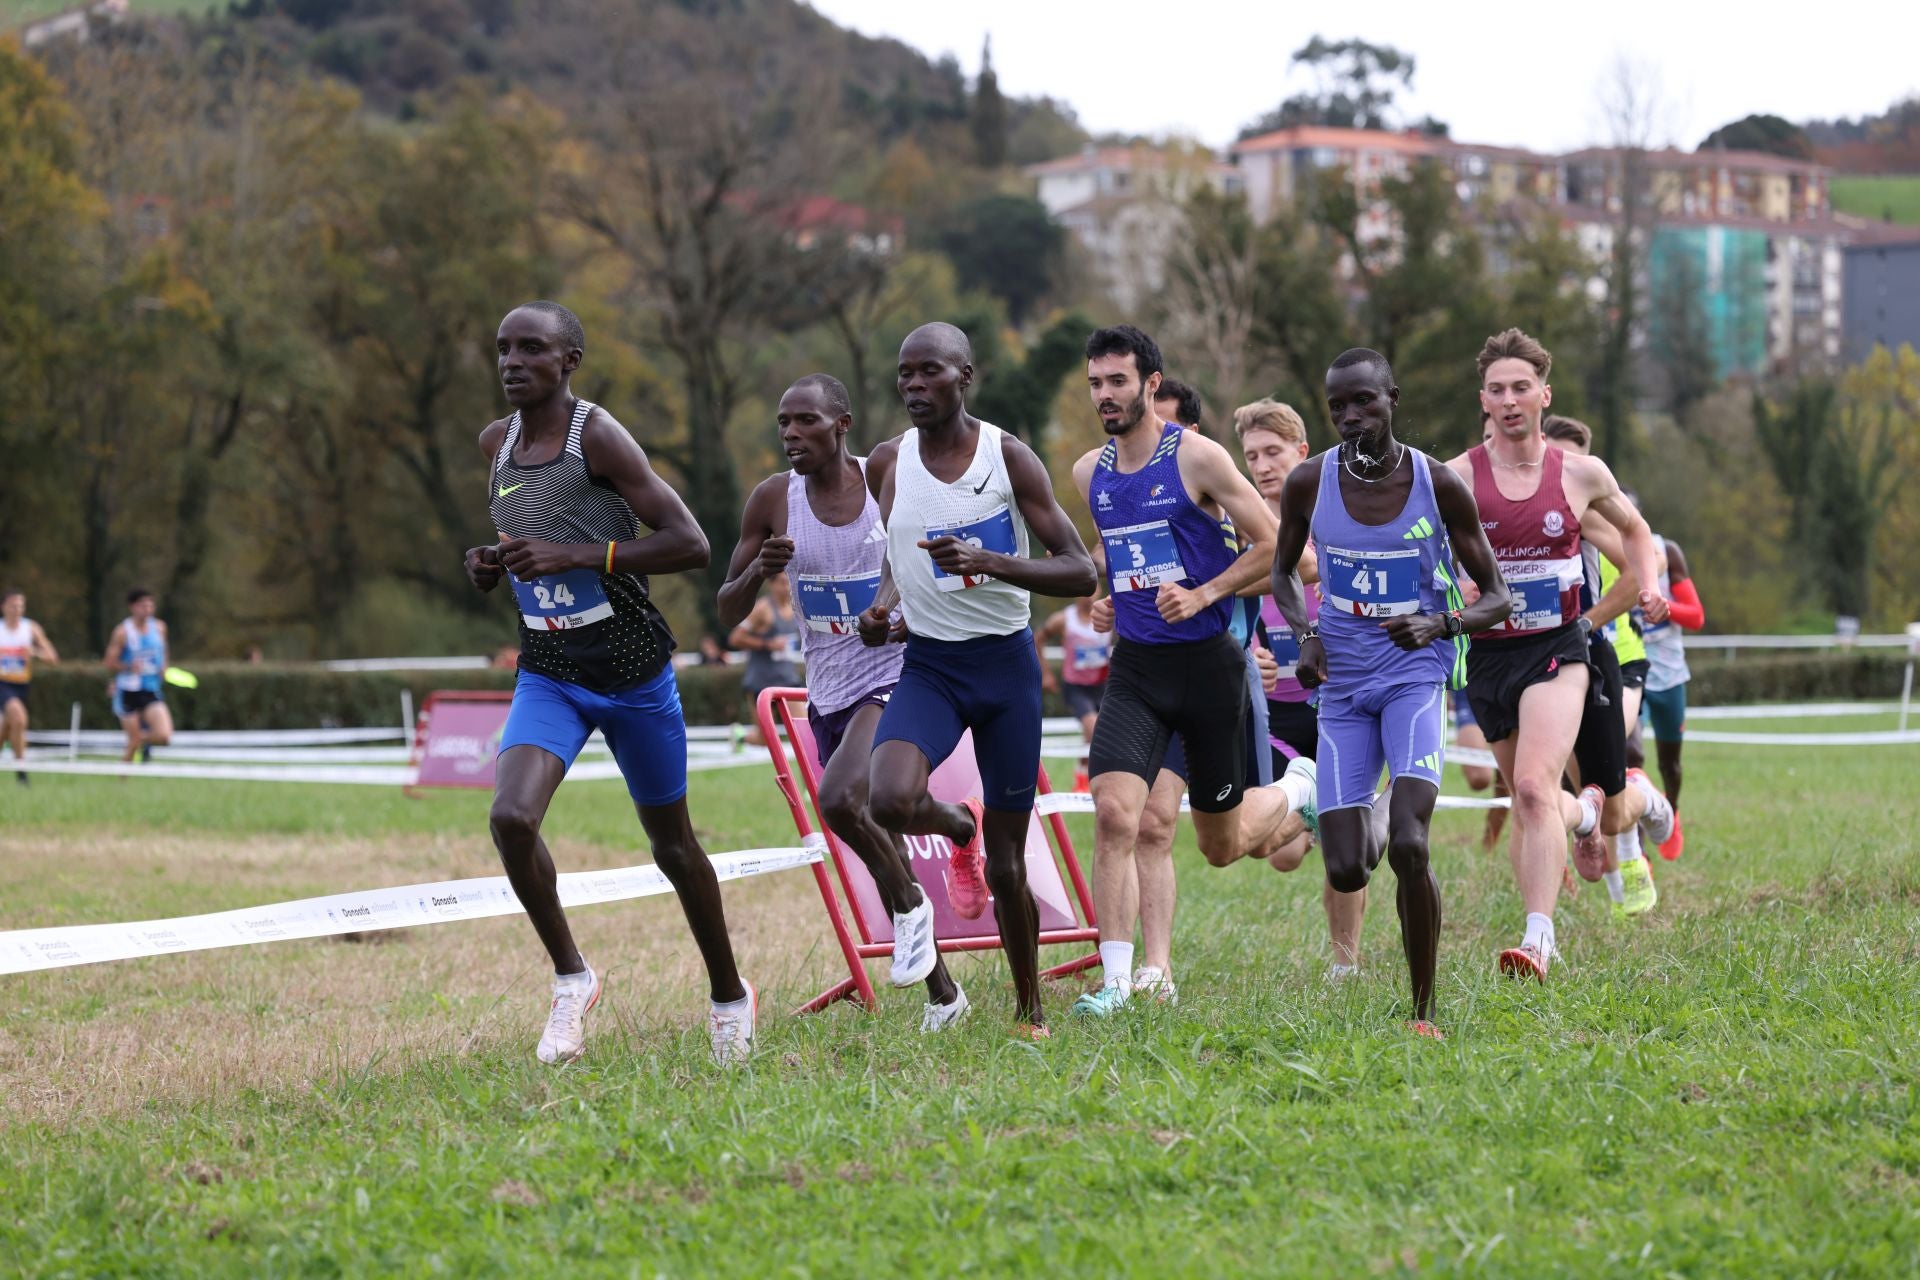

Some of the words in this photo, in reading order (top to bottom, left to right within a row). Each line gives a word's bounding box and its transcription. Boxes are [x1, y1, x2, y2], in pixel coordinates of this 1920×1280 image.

[1129, 544, 1146, 568] 3
[1492, 546, 1551, 558] ULLINGAR
[803, 584, 812, 592] 69
[1351, 570, 1387, 595] 41
[534, 584, 575, 608] 24
[835, 593, 849, 614] 1
[1511, 591, 1527, 612] 5
[1521, 609, 1552, 619] DALTON
[431, 893, 458, 906] Donostia
[341, 904, 370, 918] Donostia
